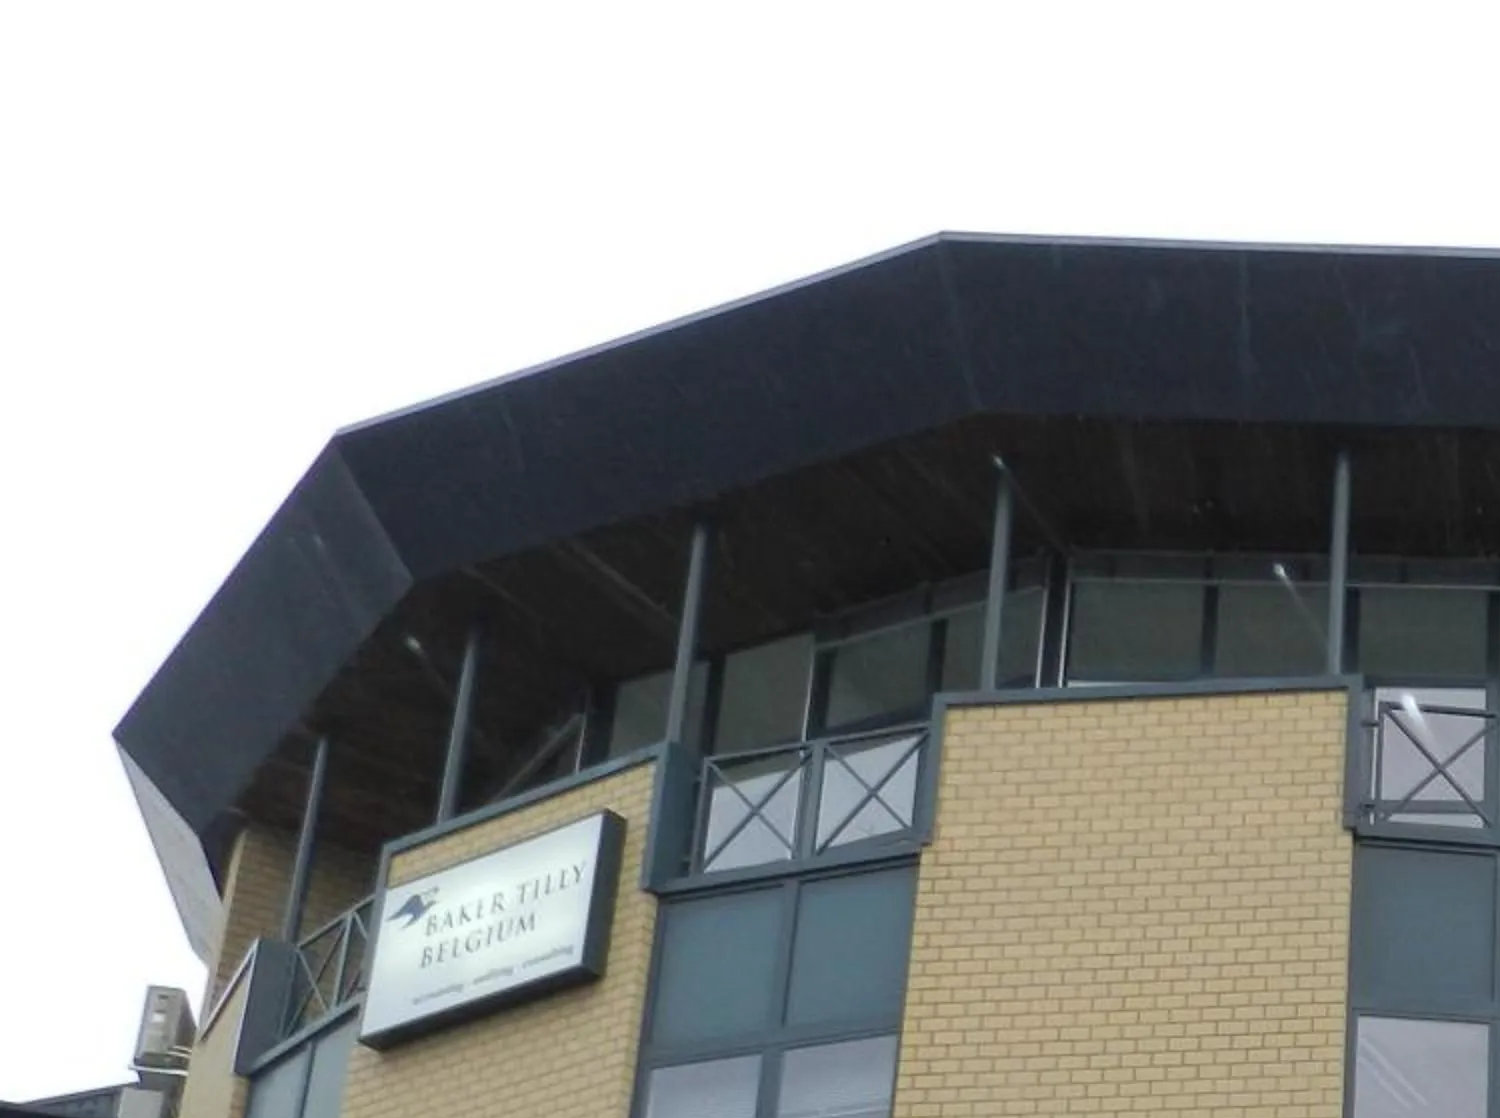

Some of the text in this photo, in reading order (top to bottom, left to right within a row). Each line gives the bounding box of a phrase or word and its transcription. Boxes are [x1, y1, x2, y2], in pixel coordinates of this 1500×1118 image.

[426, 859, 588, 938] BAKER TILLY
[420, 911, 536, 970] BELGIUM
